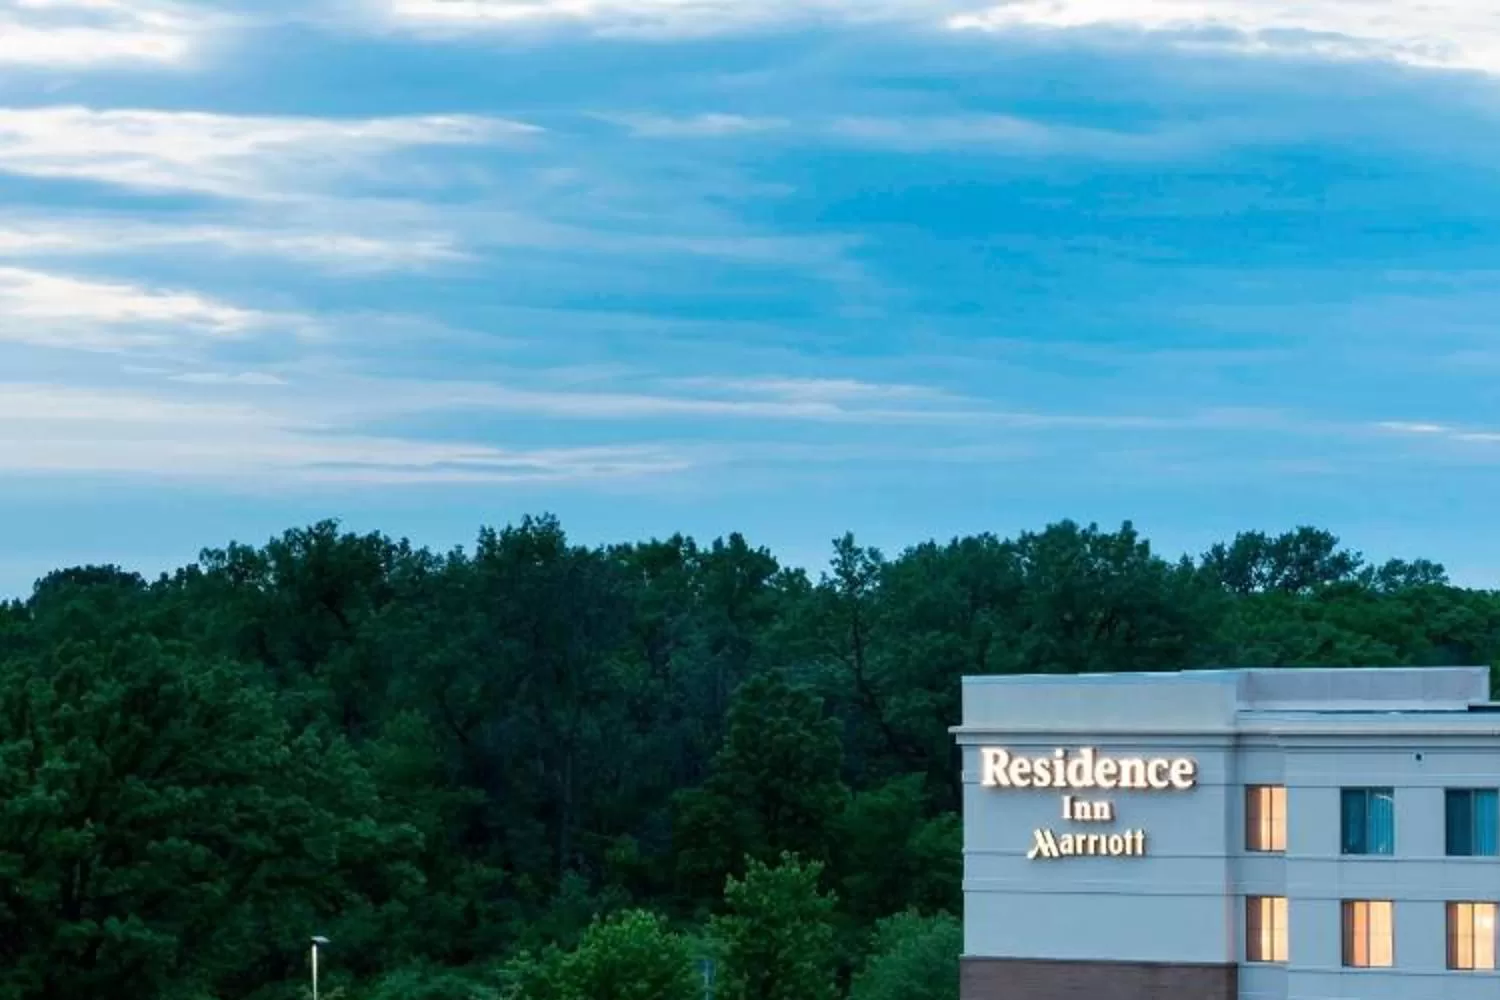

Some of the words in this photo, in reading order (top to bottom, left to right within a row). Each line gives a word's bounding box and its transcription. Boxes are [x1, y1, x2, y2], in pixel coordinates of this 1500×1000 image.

[980, 748, 1194, 789] Residence
[1062, 795, 1111, 820] Inn
[1027, 829, 1144, 859] Marriott
